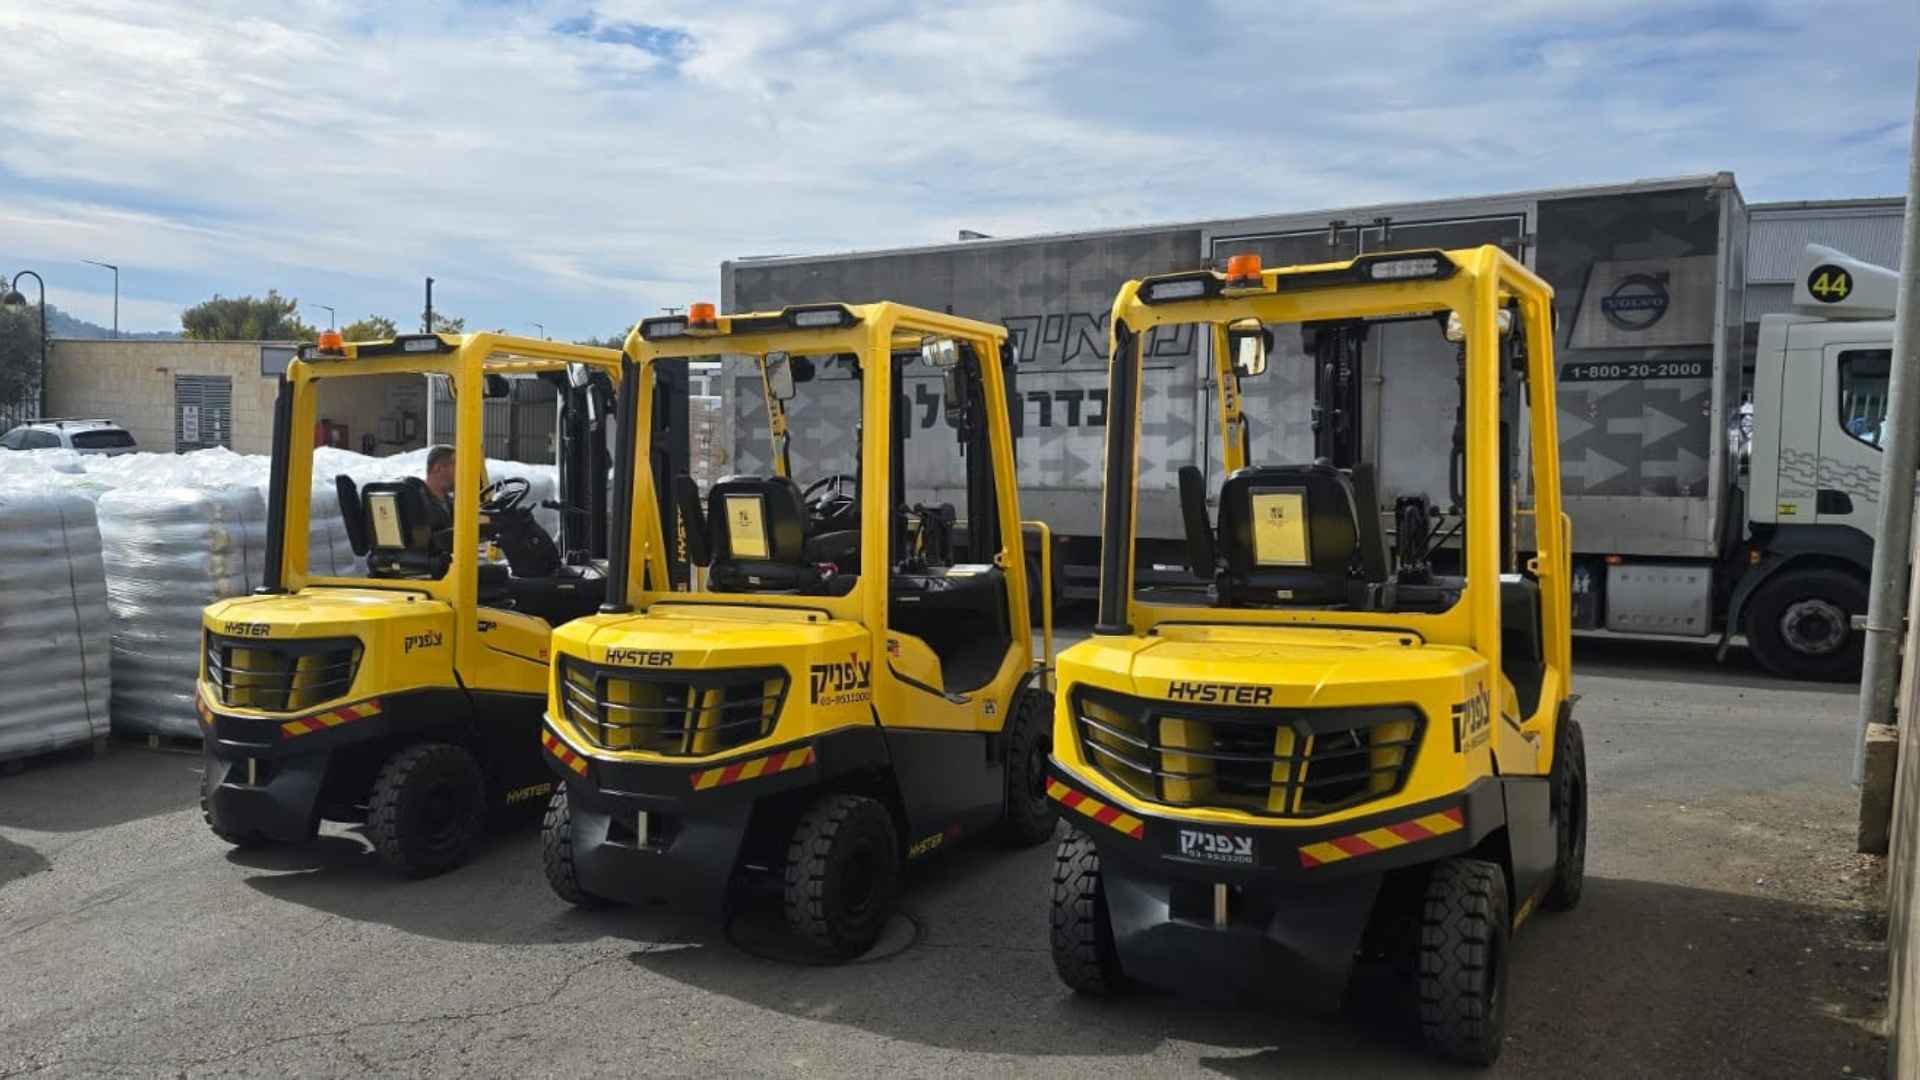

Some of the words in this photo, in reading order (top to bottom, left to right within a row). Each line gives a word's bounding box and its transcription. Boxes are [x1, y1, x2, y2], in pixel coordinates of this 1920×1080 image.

[1813, 272, 1848, 296] 44
[1571, 363, 1701, 378] 1-800-20-2000
[224, 622, 271, 636] HYSTER
[606, 648, 674, 666] HYSTER
[1168, 681, 1273, 704] HYSTER
